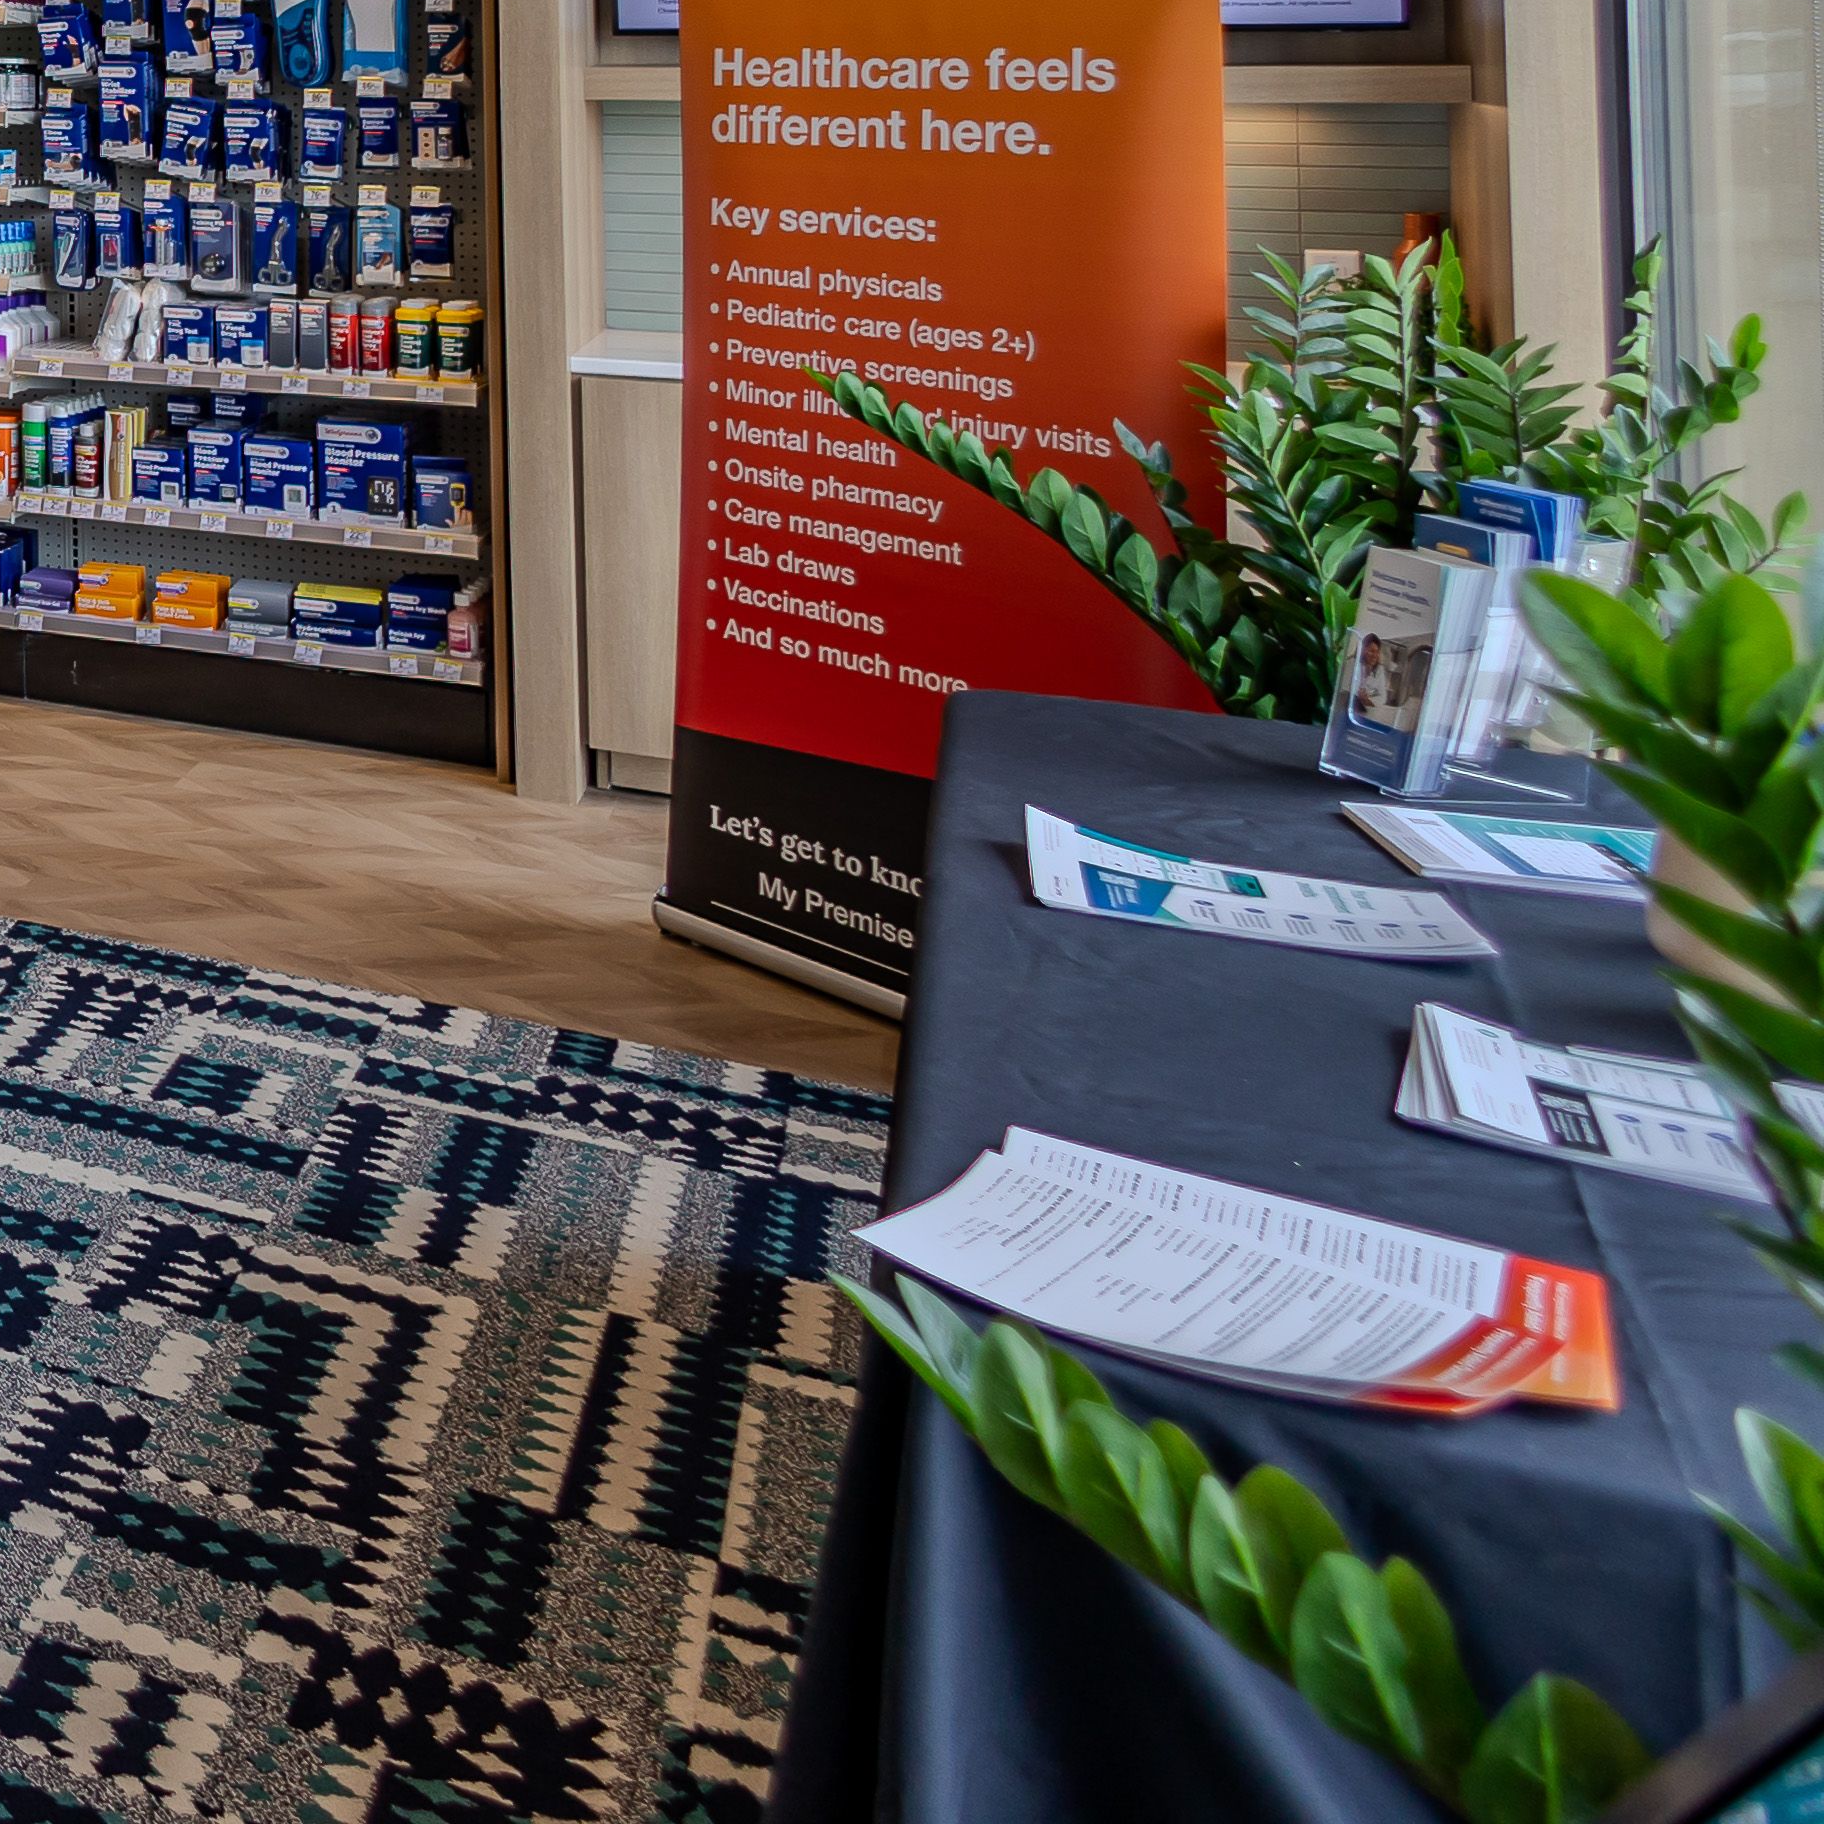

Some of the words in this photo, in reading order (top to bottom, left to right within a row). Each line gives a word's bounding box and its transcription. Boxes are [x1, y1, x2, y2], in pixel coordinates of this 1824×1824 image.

[713, 47, 970, 91] Healthcare
[985, 47, 1117, 93] feels
[712, 103, 907, 150] different
[921, 108, 1053, 156] here.
[710, 196, 770, 236] Key
[778, 206, 938, 243] services:
[726, 259, 812, 290] Annual
[818, 268, 944, 302] physicals
[726, 298, 836, 334] Pediatric
[843, 316, 902, 341] care
[908, 317, 984, 352] (ages
[990, 327, 1037, 362] 2+)
[726, 338, 857, 376] Preventive
[863, 358, 1015, 402] screenings
[725, 379, 797, 410] Minor
[802, 388, 851, 418] illn
[951, 410, 1027, 450] injury
[1035, 424, 1113, 459] visits
[194, 447, 218, 456] Blood
[194, 455, 230, 465] Pressure
[250, 458, 271, 468] Blood
[272, 460, 308, 473] Pressure
[324, 447, 353, 458] Blood
[355, 449, 400, 462] Pressure
[324, 456, 365, 467] Monitor
[725, 418, 809, 453] Mental
[815, 432, 897, 467] health
[153, 465, 181, 473] Pressure
[194, 461, 227, 471] Monitor
[250, 466, 281, 476] Monitor
[724, 458, 805, 493] Onsite
[811, 475, 944, 523] pharmacy
[724, 498, 783, 529] Care
[788, 513, 964, 566] management
[724, 537, 770, 568] Lab
[776, 549, 856, 586] draws
[390, 603, 414, 611] Poison
[723, 576, 886, 635] Vaccinations
[296, 623, 352, 637] Hydrocortisone
[296, 630, 320, 639] Cream
[388, 629, 413, 638] Poison
[723, 618, 773, 650] And
[779, 636, 811, 659] so
[818, 644, 892, 679] much
[898, 664, 969, 694] more
[709, 803, 775, 848] Let's
[780, 834, 828, 863] get
[832, 847, 863, 877] to
[757, 871, 798, 911] My
[804, 887, 915, 949] Premise
